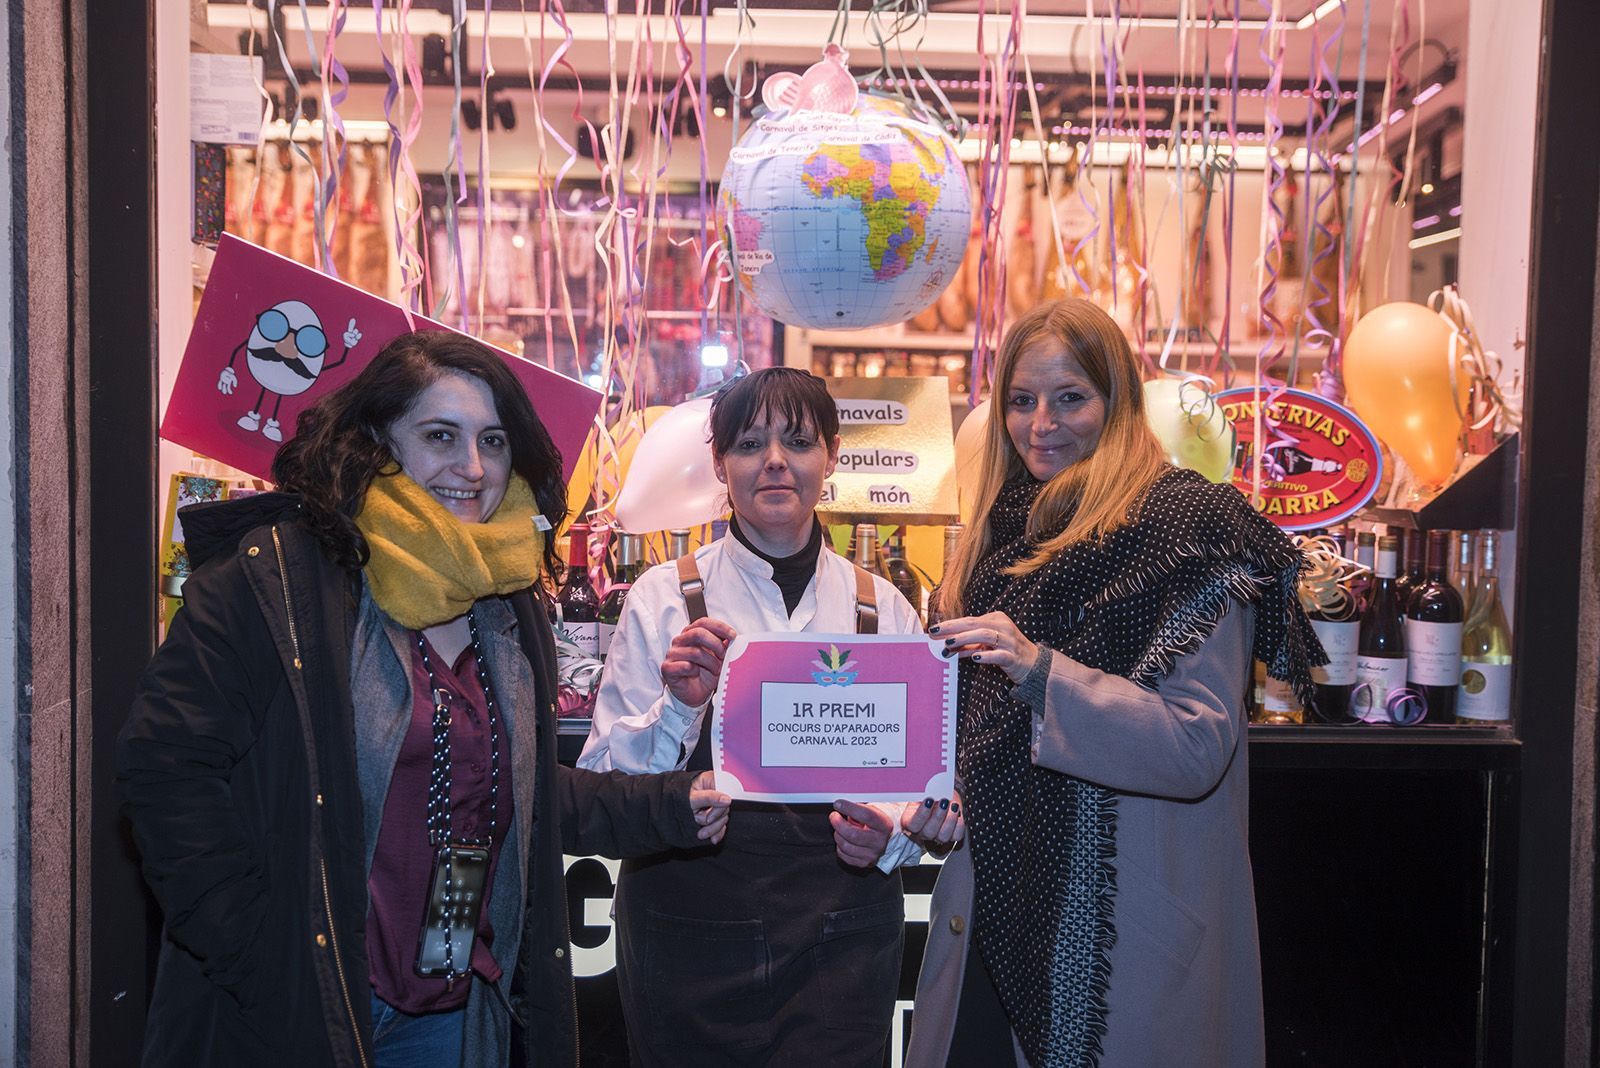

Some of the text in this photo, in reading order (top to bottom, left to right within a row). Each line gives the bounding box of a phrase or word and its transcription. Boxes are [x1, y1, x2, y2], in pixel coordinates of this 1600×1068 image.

[760, 123, 795, 133] Carnaval
[812, 124, 838, 133] Sitges
[732, 144, 815, 159] Carnaval de Tenerife
[836, 404, 904, 420] navals
[835, 449, 915, 471] opulars
[820, 484, 911, 503] el món
[792, 702, 875, 718] 1R PREMI
[767, 722, 900, 733] CONCURS D'APARADORS
[790, 735, 878, 746] CARNAVAL 2023
